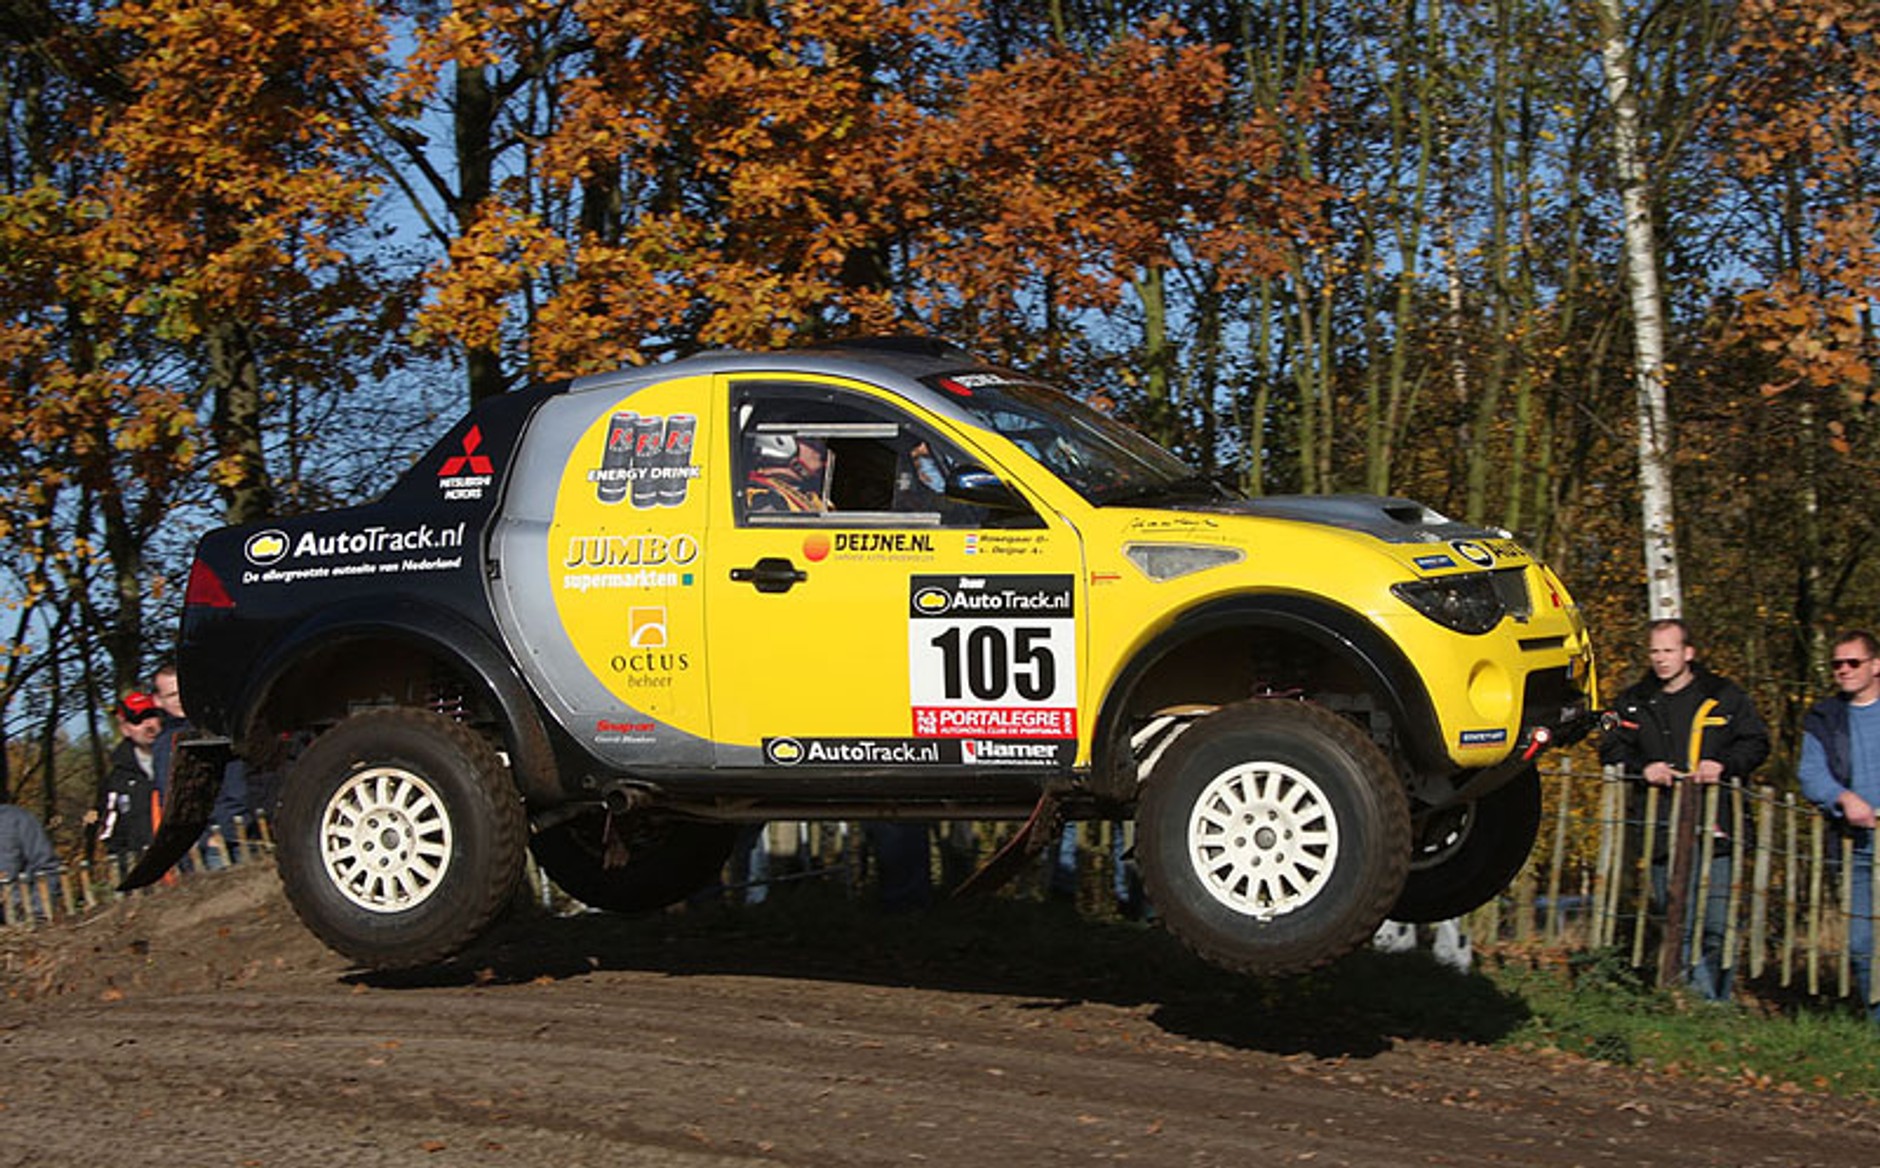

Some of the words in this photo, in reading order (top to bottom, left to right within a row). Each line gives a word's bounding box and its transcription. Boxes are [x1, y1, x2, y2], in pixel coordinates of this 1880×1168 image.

[587, 467, 648, 482] ENERGY
[650, 465, 701, 479] DRINK
[294, 522, 465, 558] AutoTrack.nl
[835, 533, 934, 552] DEIJNE.NL
[564, 534, 698, 569] JUMBO
[242, 570, 260, 583] De
[332, 563, 377, 577] autosite
[379, 562, 399, 573] van
[401, 556, 462, 572] Nederland
[563, 568, 678, 593] supermarkten
[952, 591, 1070, 610] AutoTrack.nl
[610, 647, 689, 673] octus
[931, 625, 1056, 701] 105
[627, 674, 673, 689] beheer
[940, 710, 1061, 727] PORTALEGRE
[808, 741, 939, 762] AutoTrack.nl
[977, 740, 1059, 758] Hamer
